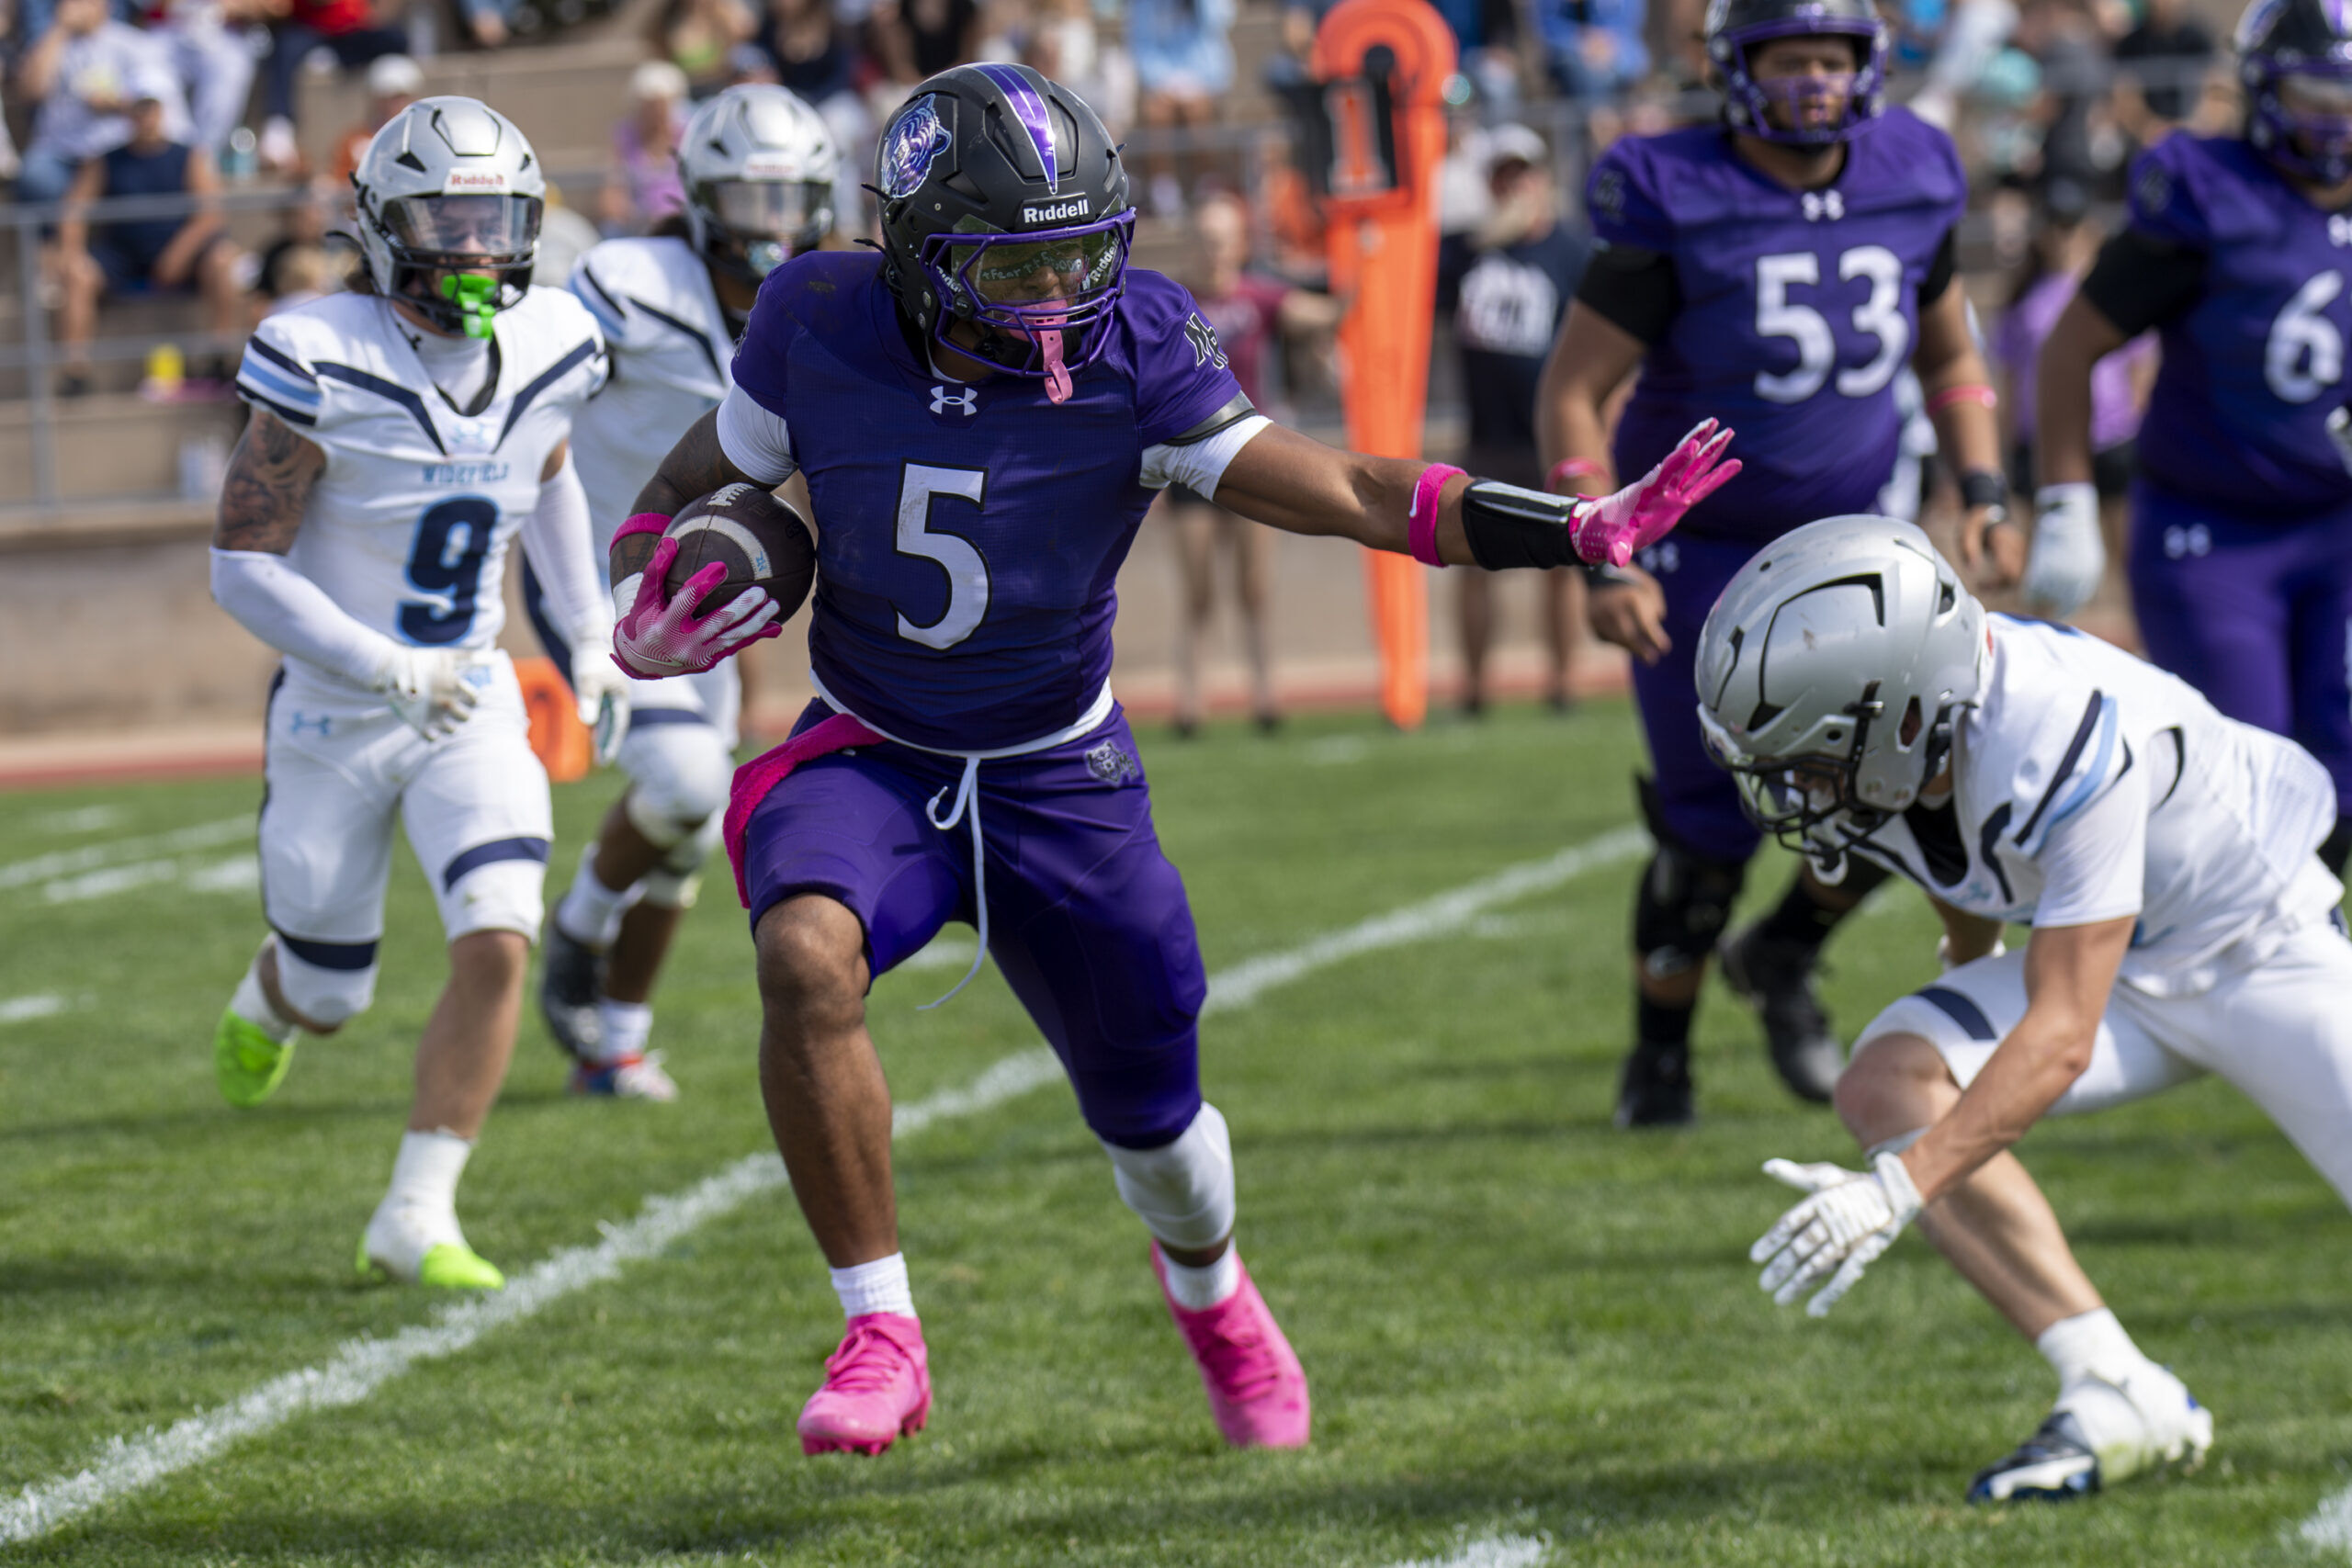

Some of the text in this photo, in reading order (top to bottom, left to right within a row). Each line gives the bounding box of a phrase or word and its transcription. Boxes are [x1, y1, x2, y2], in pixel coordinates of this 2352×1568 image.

[1023, 198, 1089, 223] Riddell
[1753, 244, 1911, 405] 53
[2263, 268, 2352, 404] 6
[395, 493, 500, 647] 9
[888, 457, 993, 653] 5
